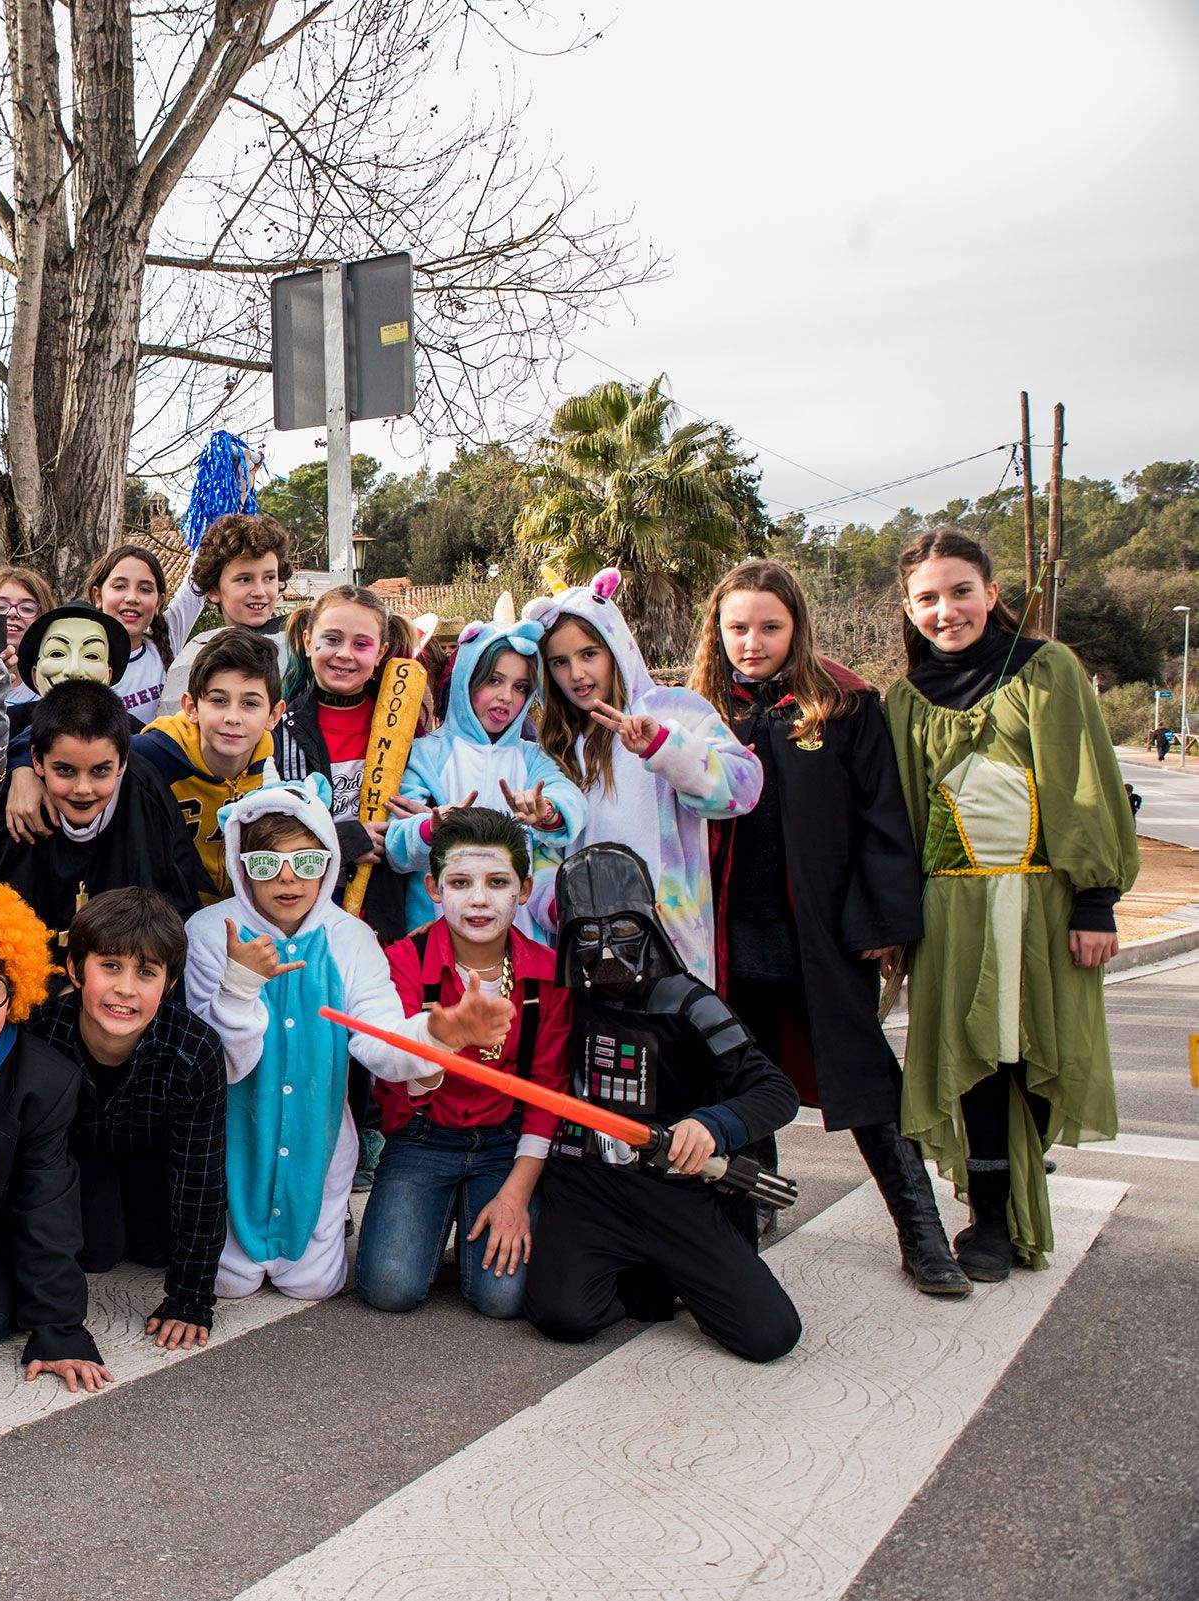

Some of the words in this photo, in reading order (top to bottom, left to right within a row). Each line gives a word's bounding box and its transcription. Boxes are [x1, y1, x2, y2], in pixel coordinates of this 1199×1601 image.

[387, 663, 410, 727] GOOD
[367, 737, 392, 821] NIGHT
[249, 854, 278, 874] Perrier
[294, 853, 325, 870] Perrier
